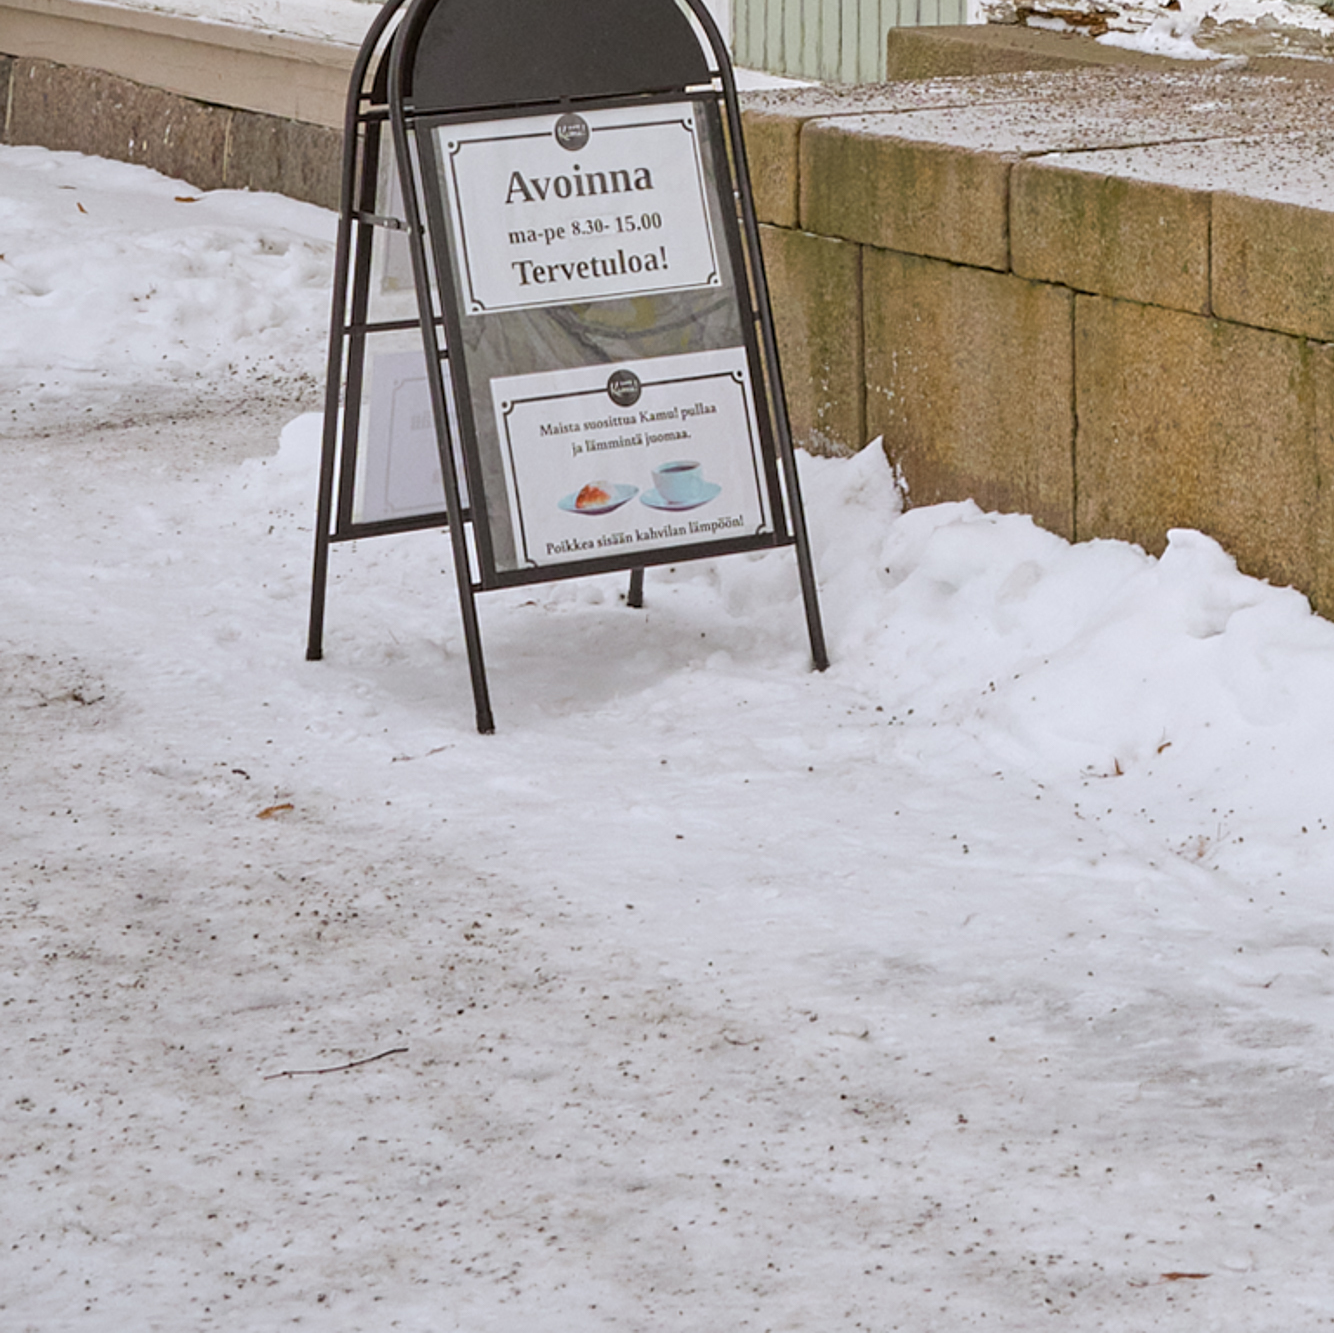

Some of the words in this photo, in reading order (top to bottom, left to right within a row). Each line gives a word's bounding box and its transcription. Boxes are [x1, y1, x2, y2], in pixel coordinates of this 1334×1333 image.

[505, 164, 655, 204] Avoinna
[508, 226, 566, 245] ma-pe
[571, 218, 610, 236] 8.30-
[615, 212, 663, 233] 15.00
[511, 246, 669, 286] Tervetuloa!
[539, 420, 581, 437] Maista
[583, 414, 637, 431] suosittua
[638, 406, 679, 423] Kamu!
[681, 402, 717, 421] pullaa
[571, 442, 583, 456] ja
[584, 432, 644, 452] lämmintä
[644, 429, 692, 447] juomaa.
[546, 537, 595, 555] Poikkea
[597, 531, 633, 548] sisään
[635, 525, 687, 542] kahvilan
[688, 515, 745, 534] lämpöön!
